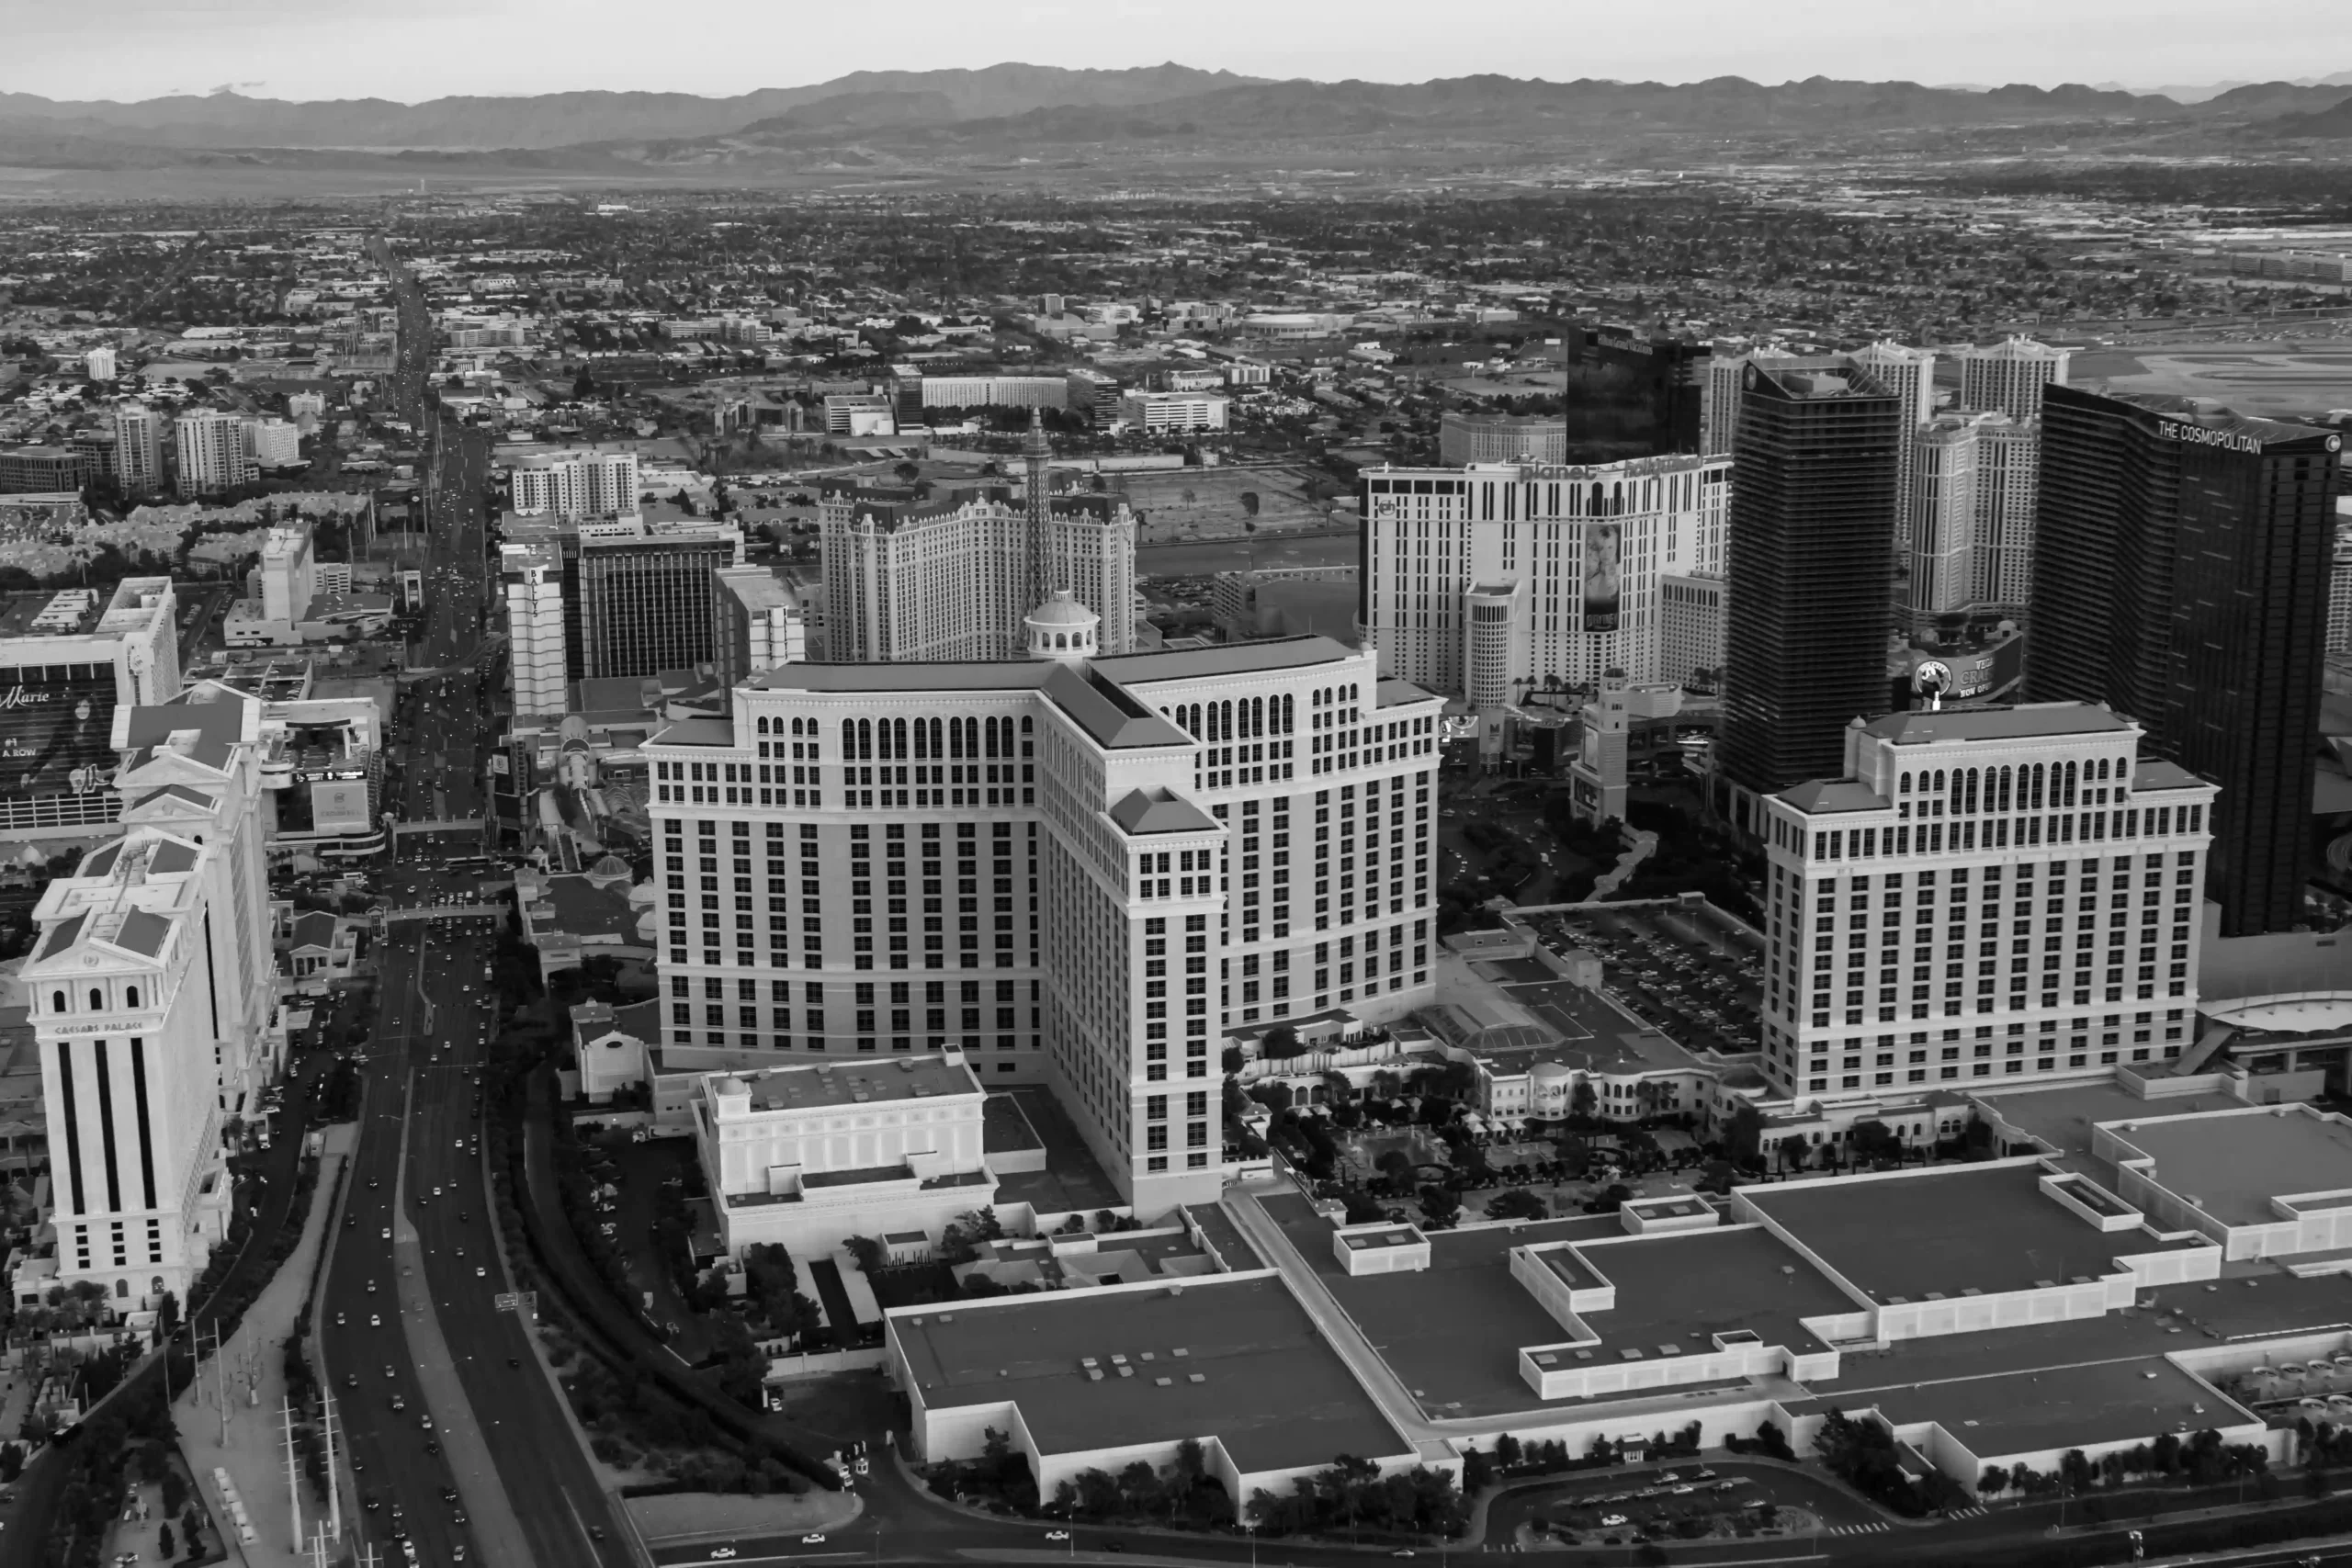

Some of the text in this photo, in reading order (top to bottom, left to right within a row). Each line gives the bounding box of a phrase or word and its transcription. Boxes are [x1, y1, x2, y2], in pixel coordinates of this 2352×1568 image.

[2158, 421, 2262, 455] THE COSMOPOLITAN
[1520, 460, 1598, 484] planet
[13, 749, 36, 757] ROW
[55, 1021, 142, 1034] CAESARS PALACE
